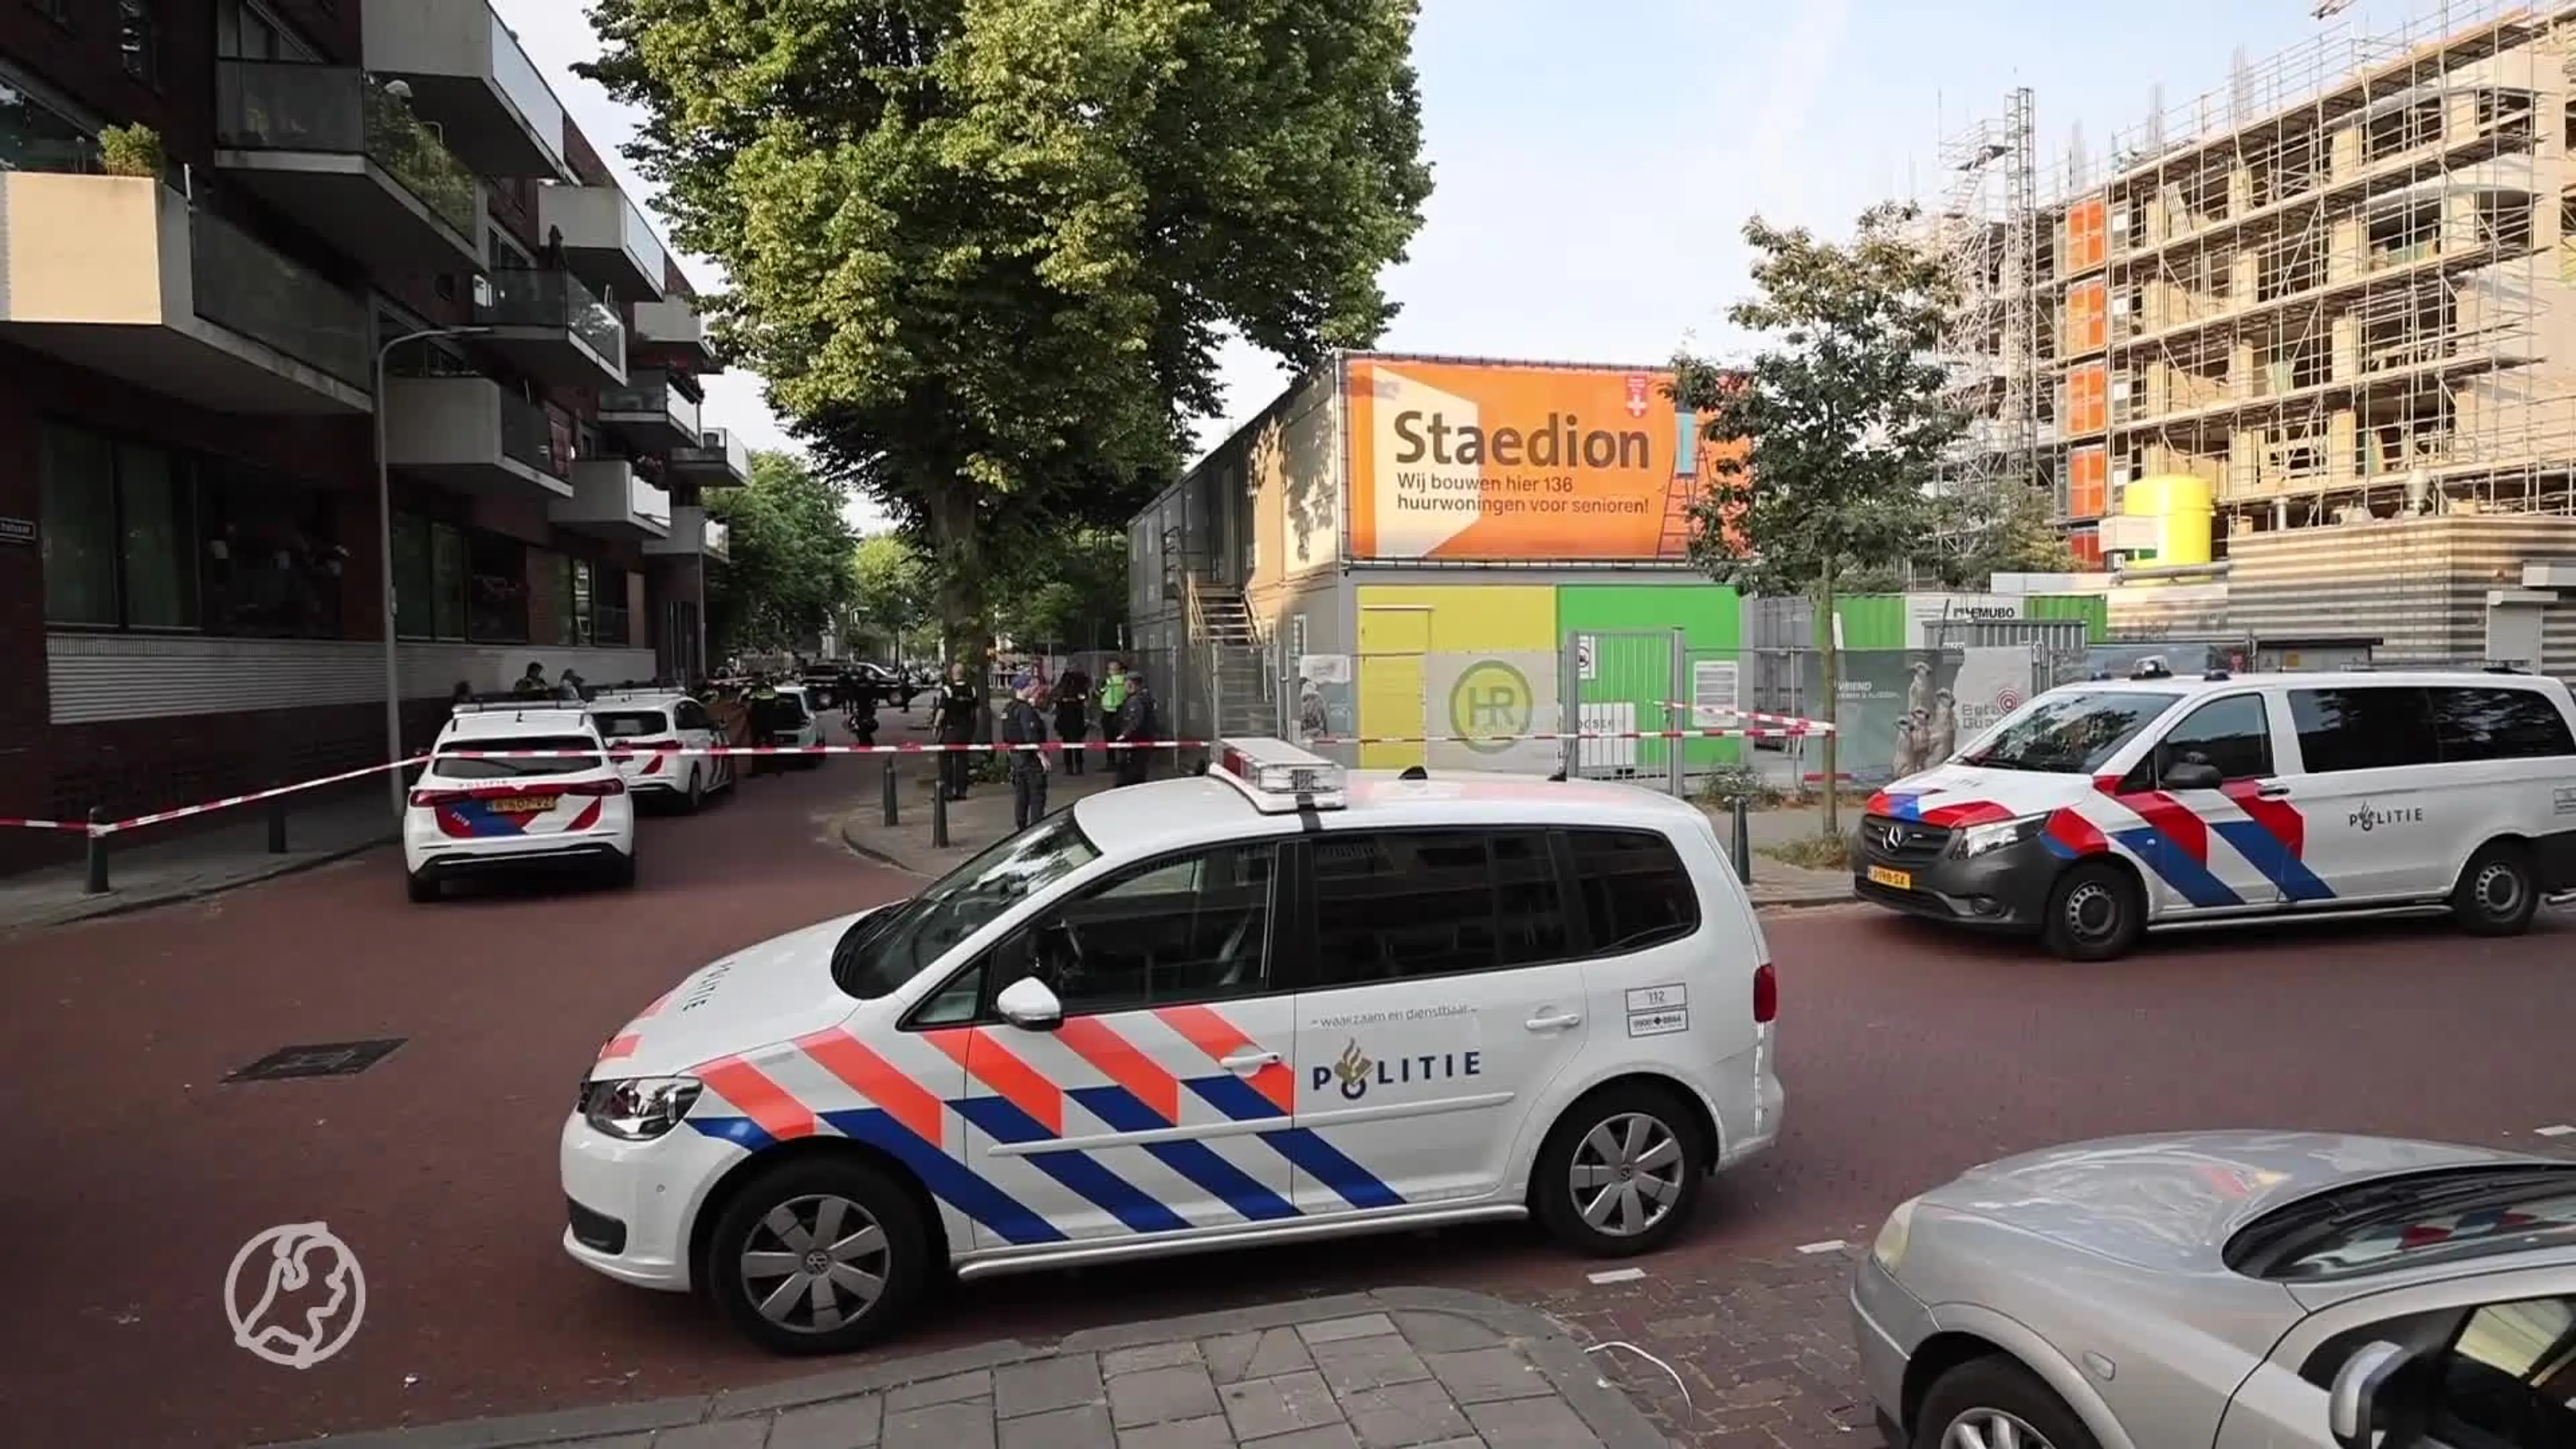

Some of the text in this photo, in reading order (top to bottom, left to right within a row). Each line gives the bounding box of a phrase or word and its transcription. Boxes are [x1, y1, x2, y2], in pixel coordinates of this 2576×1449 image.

[1393, 410, 1650, 468] Staedion
[1397, 472, 1573, 492] Wij bouwen hier 136
[1397, 494, 1649, 516] huurwoningen voor senioren!
[1468, 686, 1515, 726] HR
[2349, 807, 2423, 832] POLITIE
[1648, 990, 1665, 1005] 112
[1388, 1012, 1403, 1022] en
[1312, 1051, 1481, 1100] POLITIE
